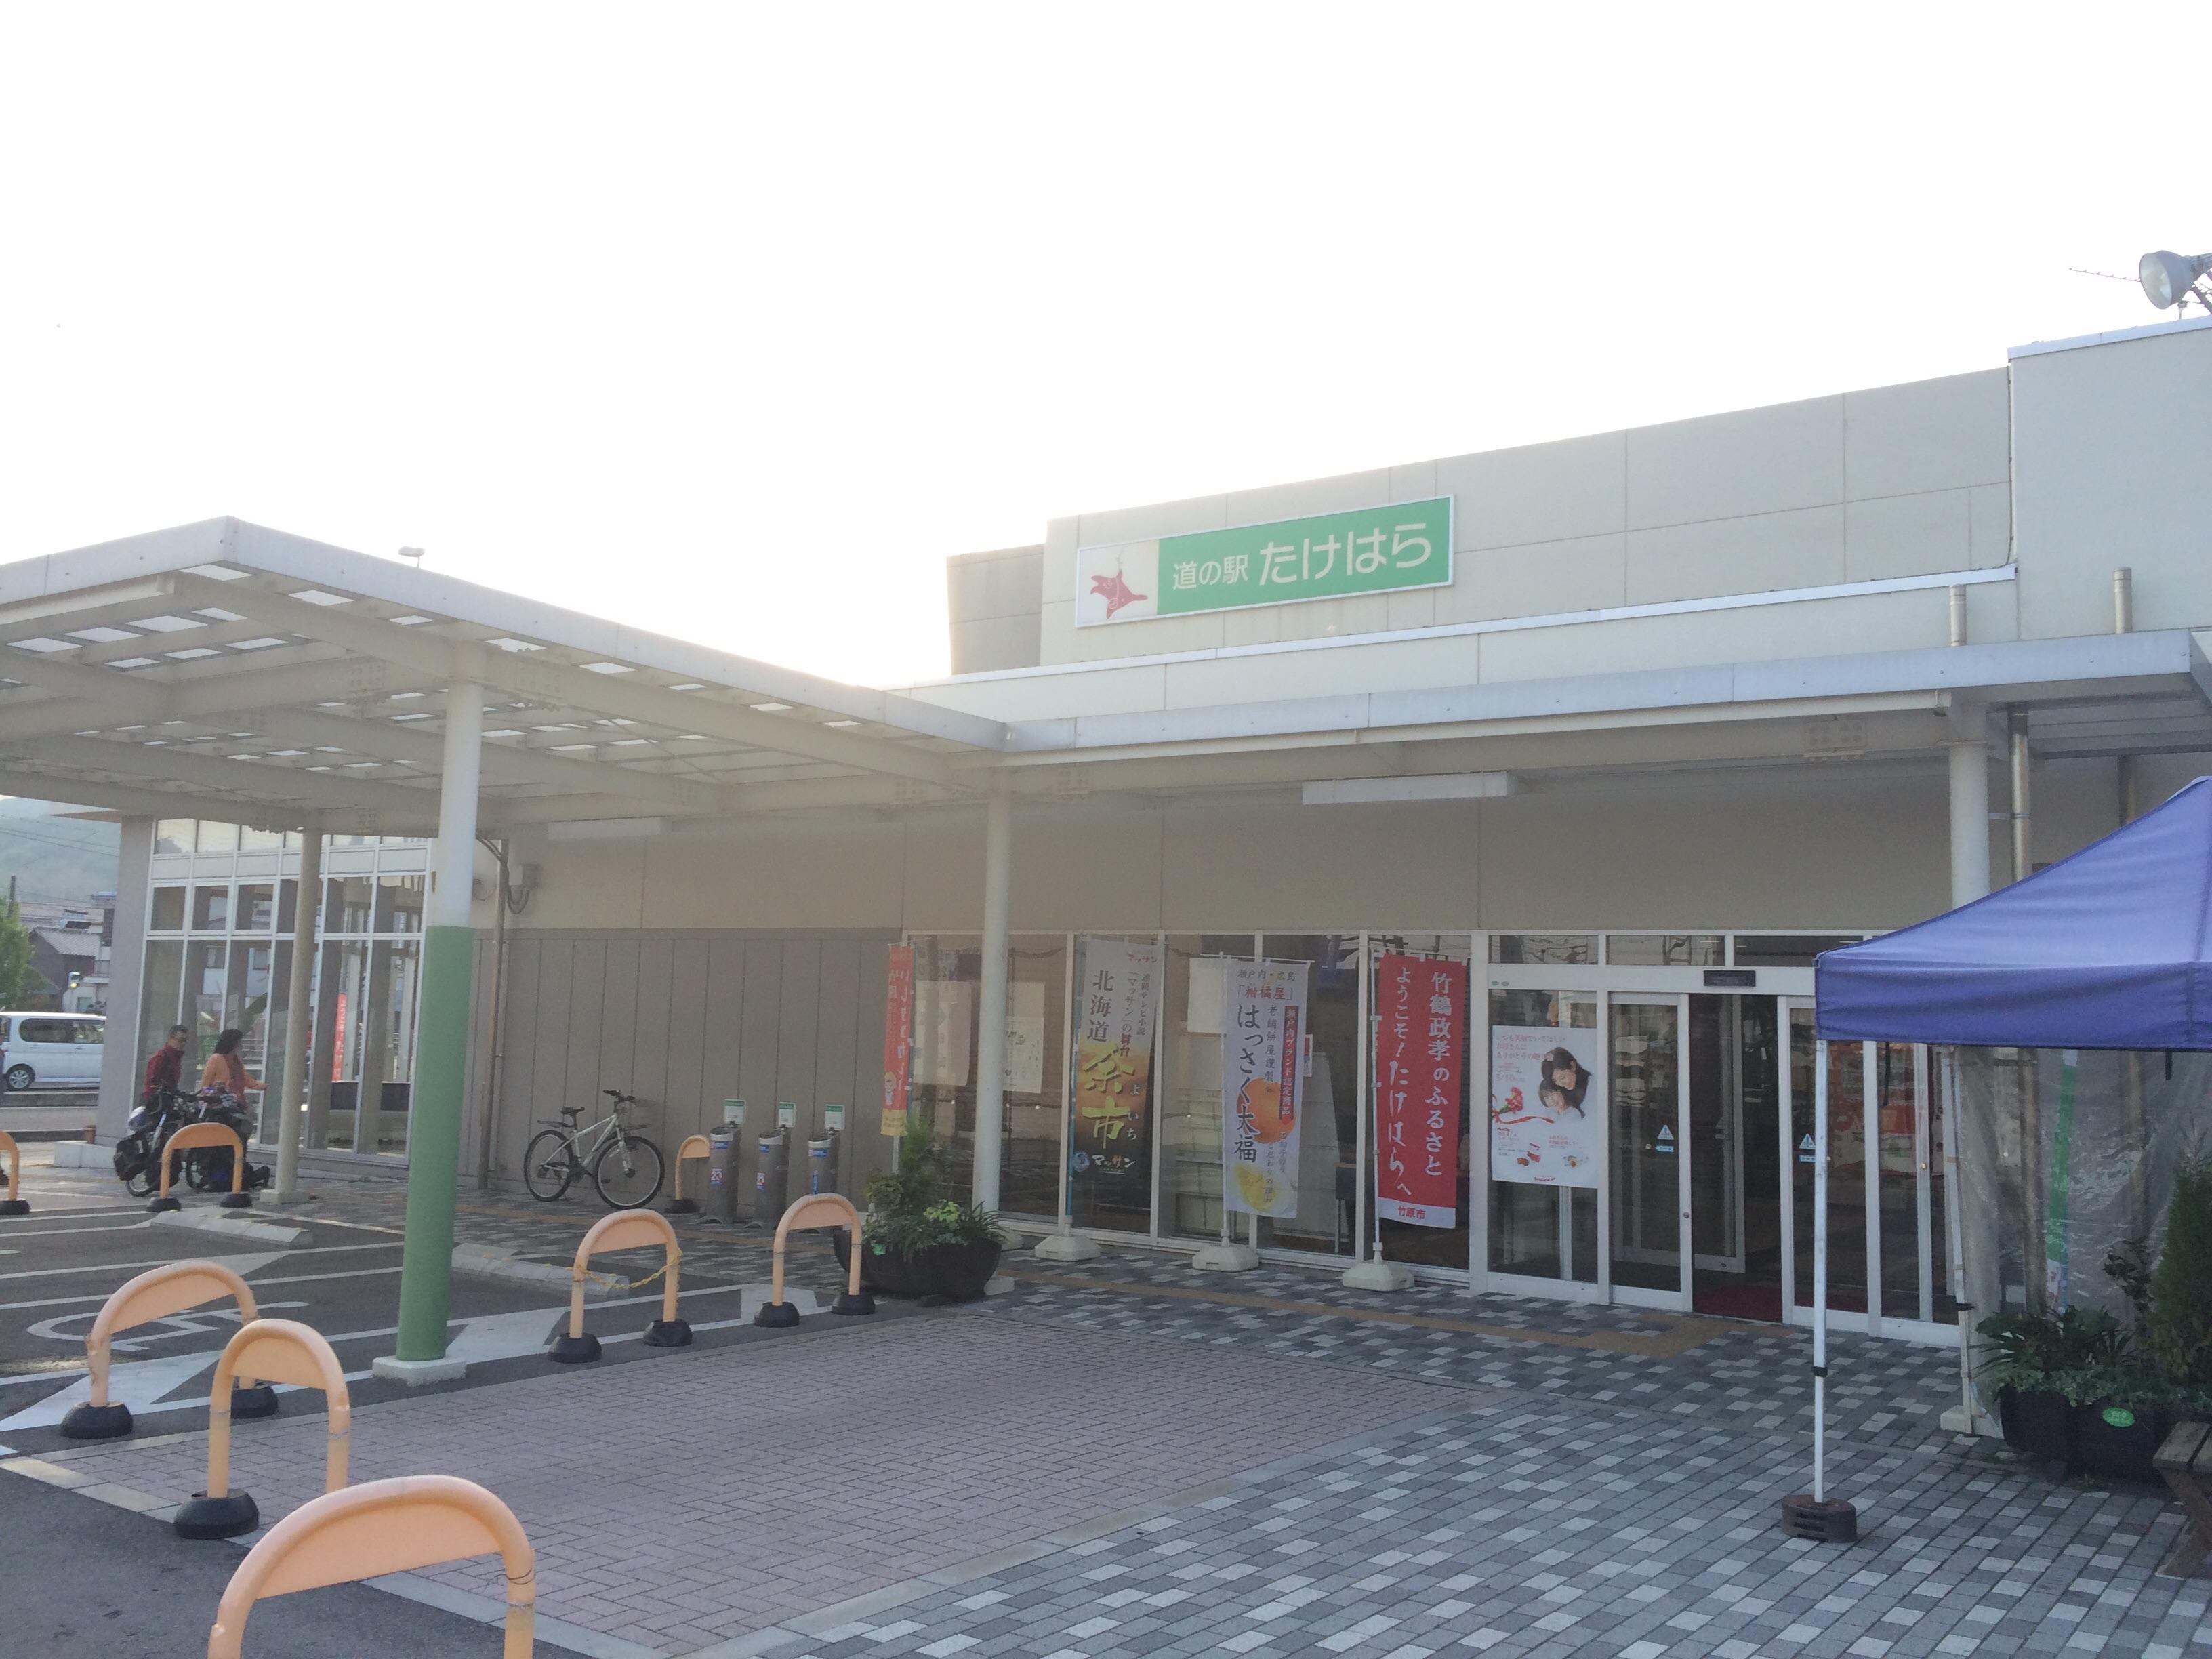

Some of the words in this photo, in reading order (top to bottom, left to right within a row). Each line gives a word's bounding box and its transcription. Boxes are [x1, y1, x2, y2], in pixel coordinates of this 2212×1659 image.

[1172, 554, 1248, 590] 道の駅
[1259, 523, 1431, 586] たけはら
[1087, 970, 1115, 1042] 北海道
[1136, 973, 1151, 1036] 連続テレビ小説
[1081, 1040, 1136, 1149] 余市
[1233, 1004, 1264, 1163] はっさく大福
[1425, 972, 1453, 1176] 竹鶴政孝のふるさと
[1127, 1084, 1141, 1140] よいち
[1092, 1154, 1136, 1168] マッサン
[1398, 1206, 1426, 1220] 竹原市
